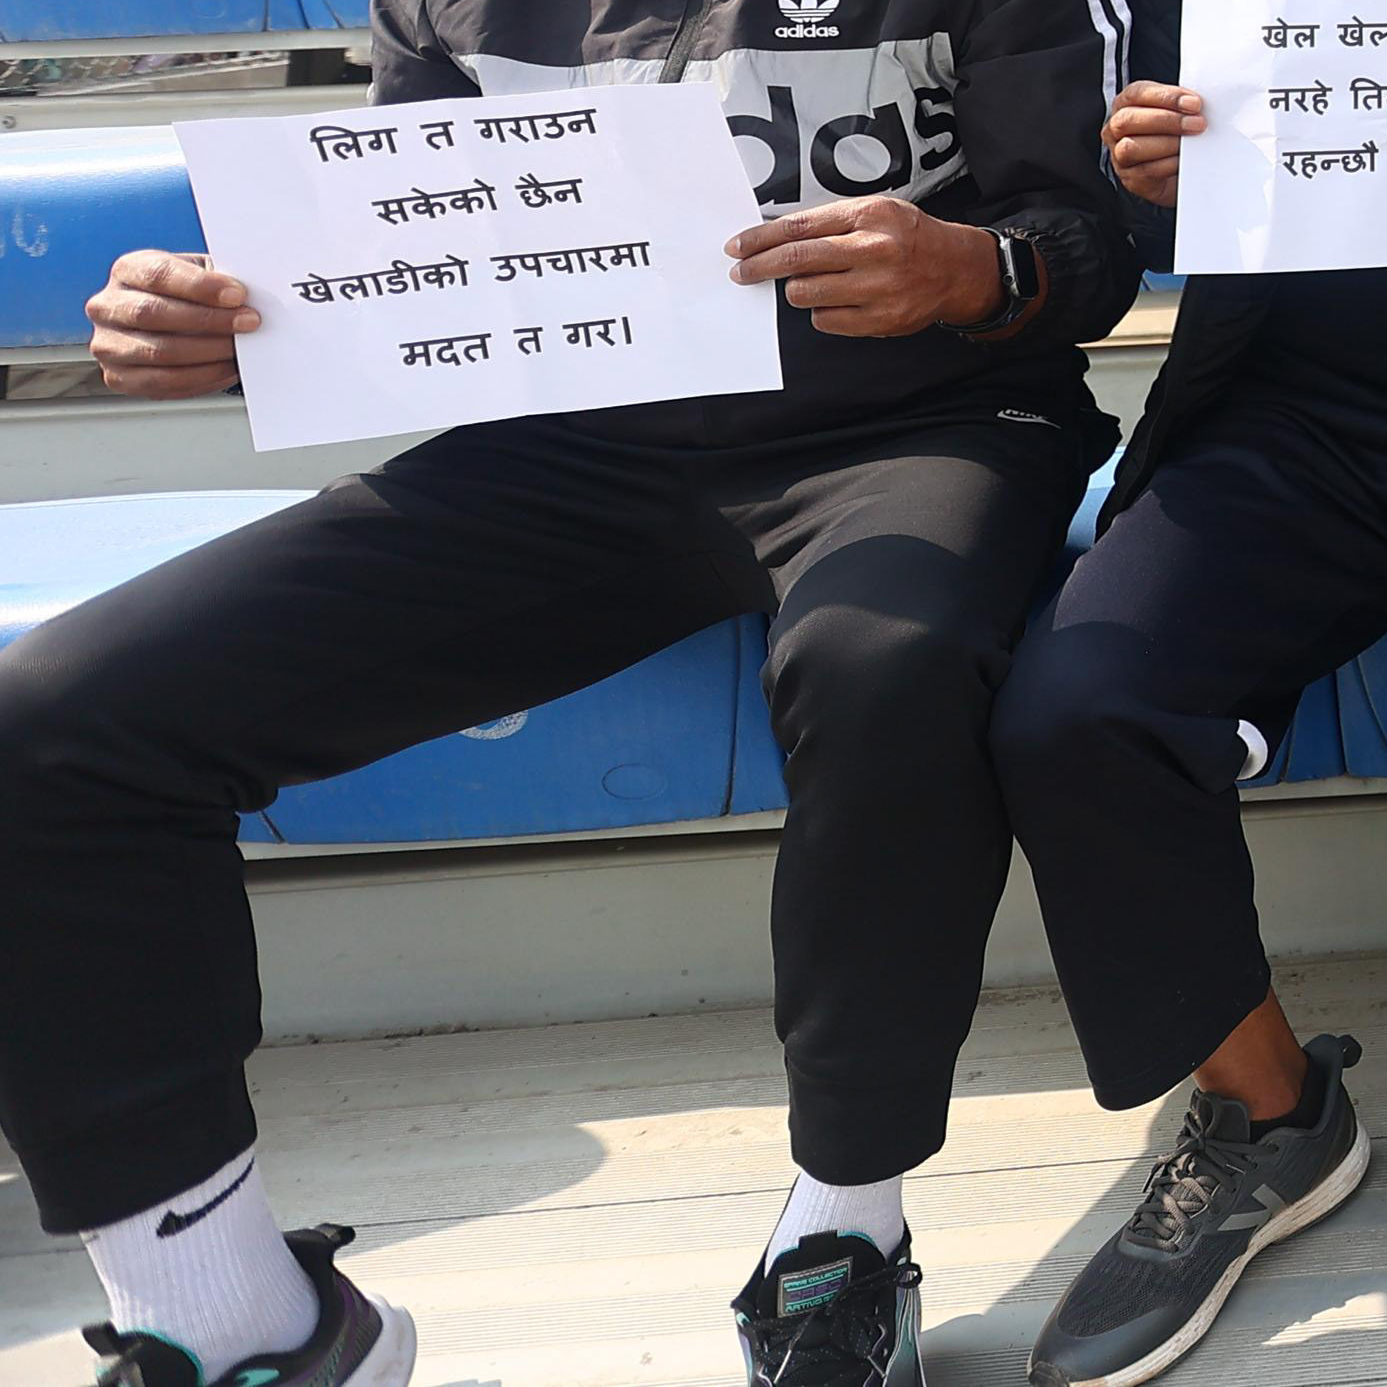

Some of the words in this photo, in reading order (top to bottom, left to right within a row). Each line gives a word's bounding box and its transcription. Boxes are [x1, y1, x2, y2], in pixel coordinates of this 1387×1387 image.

[774, 23, 840, 39] adidas
[1262, 18, 1320, 48] खेल
[1269, 80, 1332, 115] नरहे
[310, 126, 397, 162] लिग
[420, 121, 454, 150] त
[474, 109, 596, 142] गराउन
[1282, 141, 1379, 179] रहन्छौ
[372, 179, 497, 225] सकेको
[515, 173, 582, 208] छैन
[292, 254, 469, 303] खेलाडीको
[490, 242, 649, 281] उपचारमा
[399, 333, 491, 366] मदत
[514, 327, 543, 355] त
[563, 317, 632, 347] गर।
